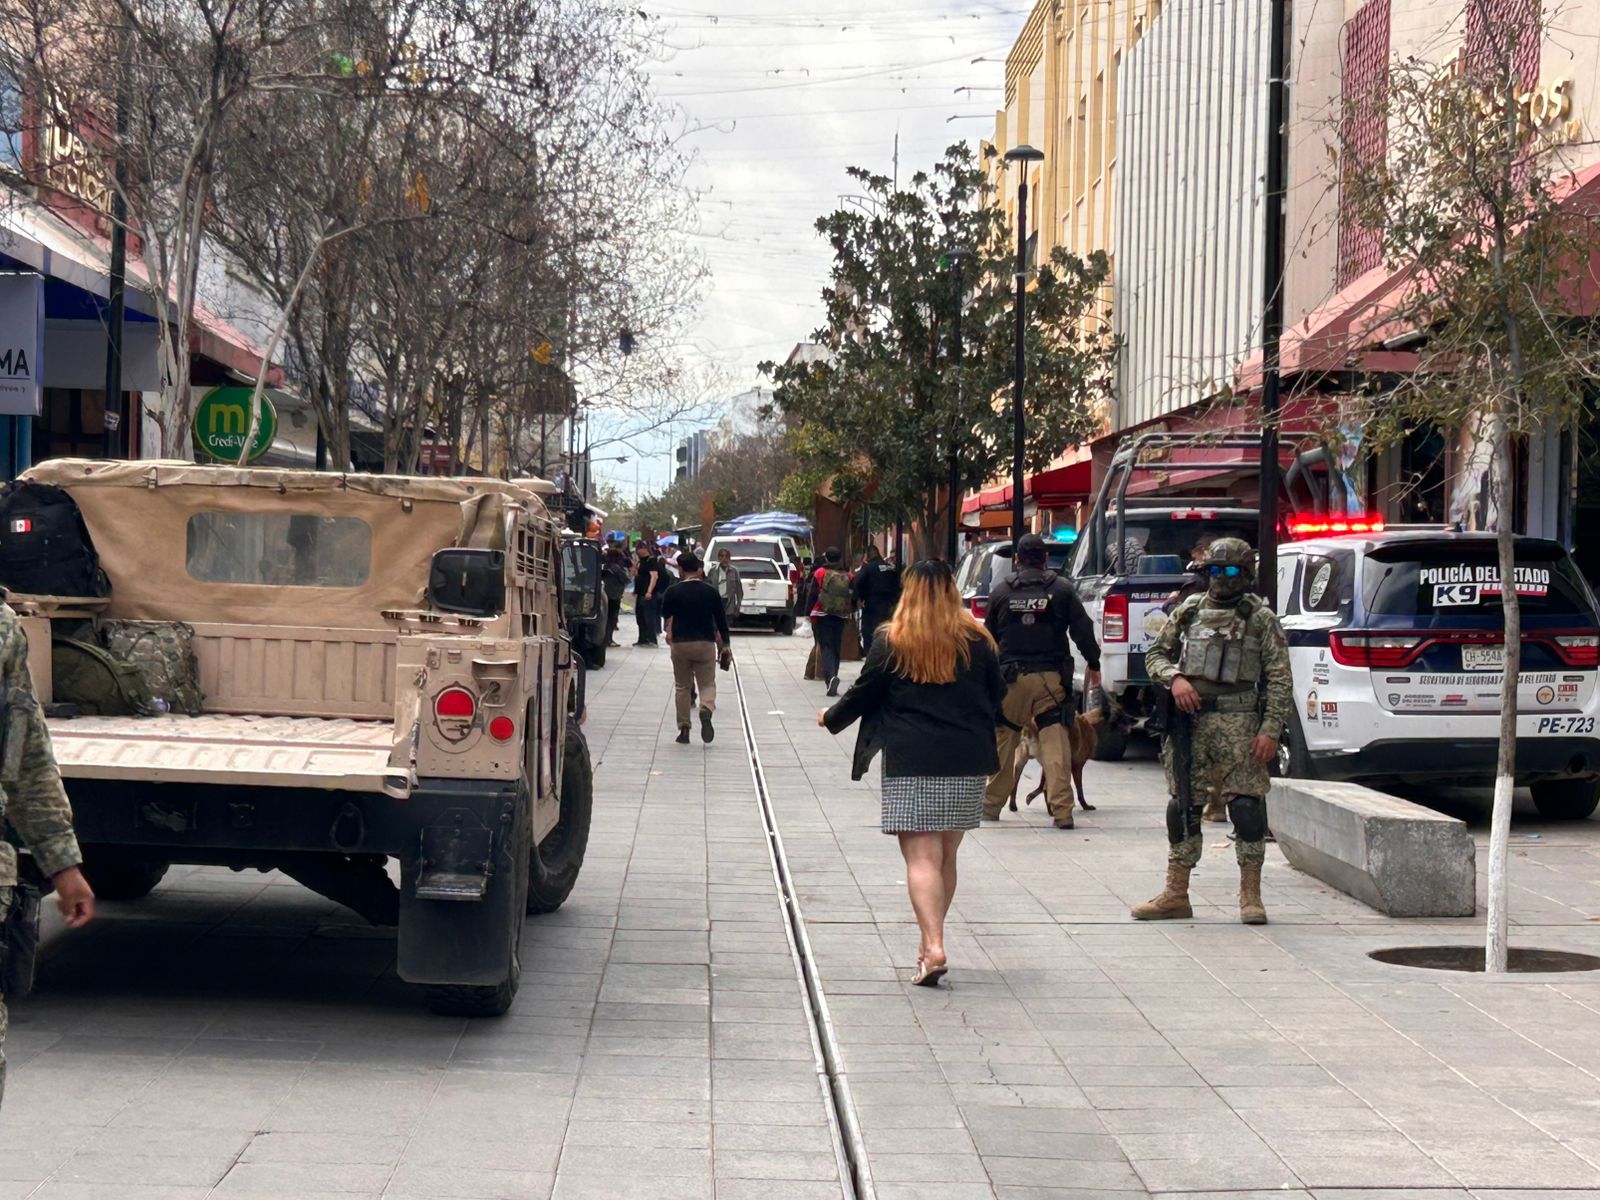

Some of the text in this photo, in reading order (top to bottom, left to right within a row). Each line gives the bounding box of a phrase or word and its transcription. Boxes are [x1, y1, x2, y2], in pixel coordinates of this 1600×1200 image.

[1420, 563, 1473, 585] POLICÍA
[1475, 566, 1500, 582] DEL
[1437, 585, 1478, 604] K9
[1027, 599, 1048, 609] K9
[1537, 717, 1595, 734] PE-723
